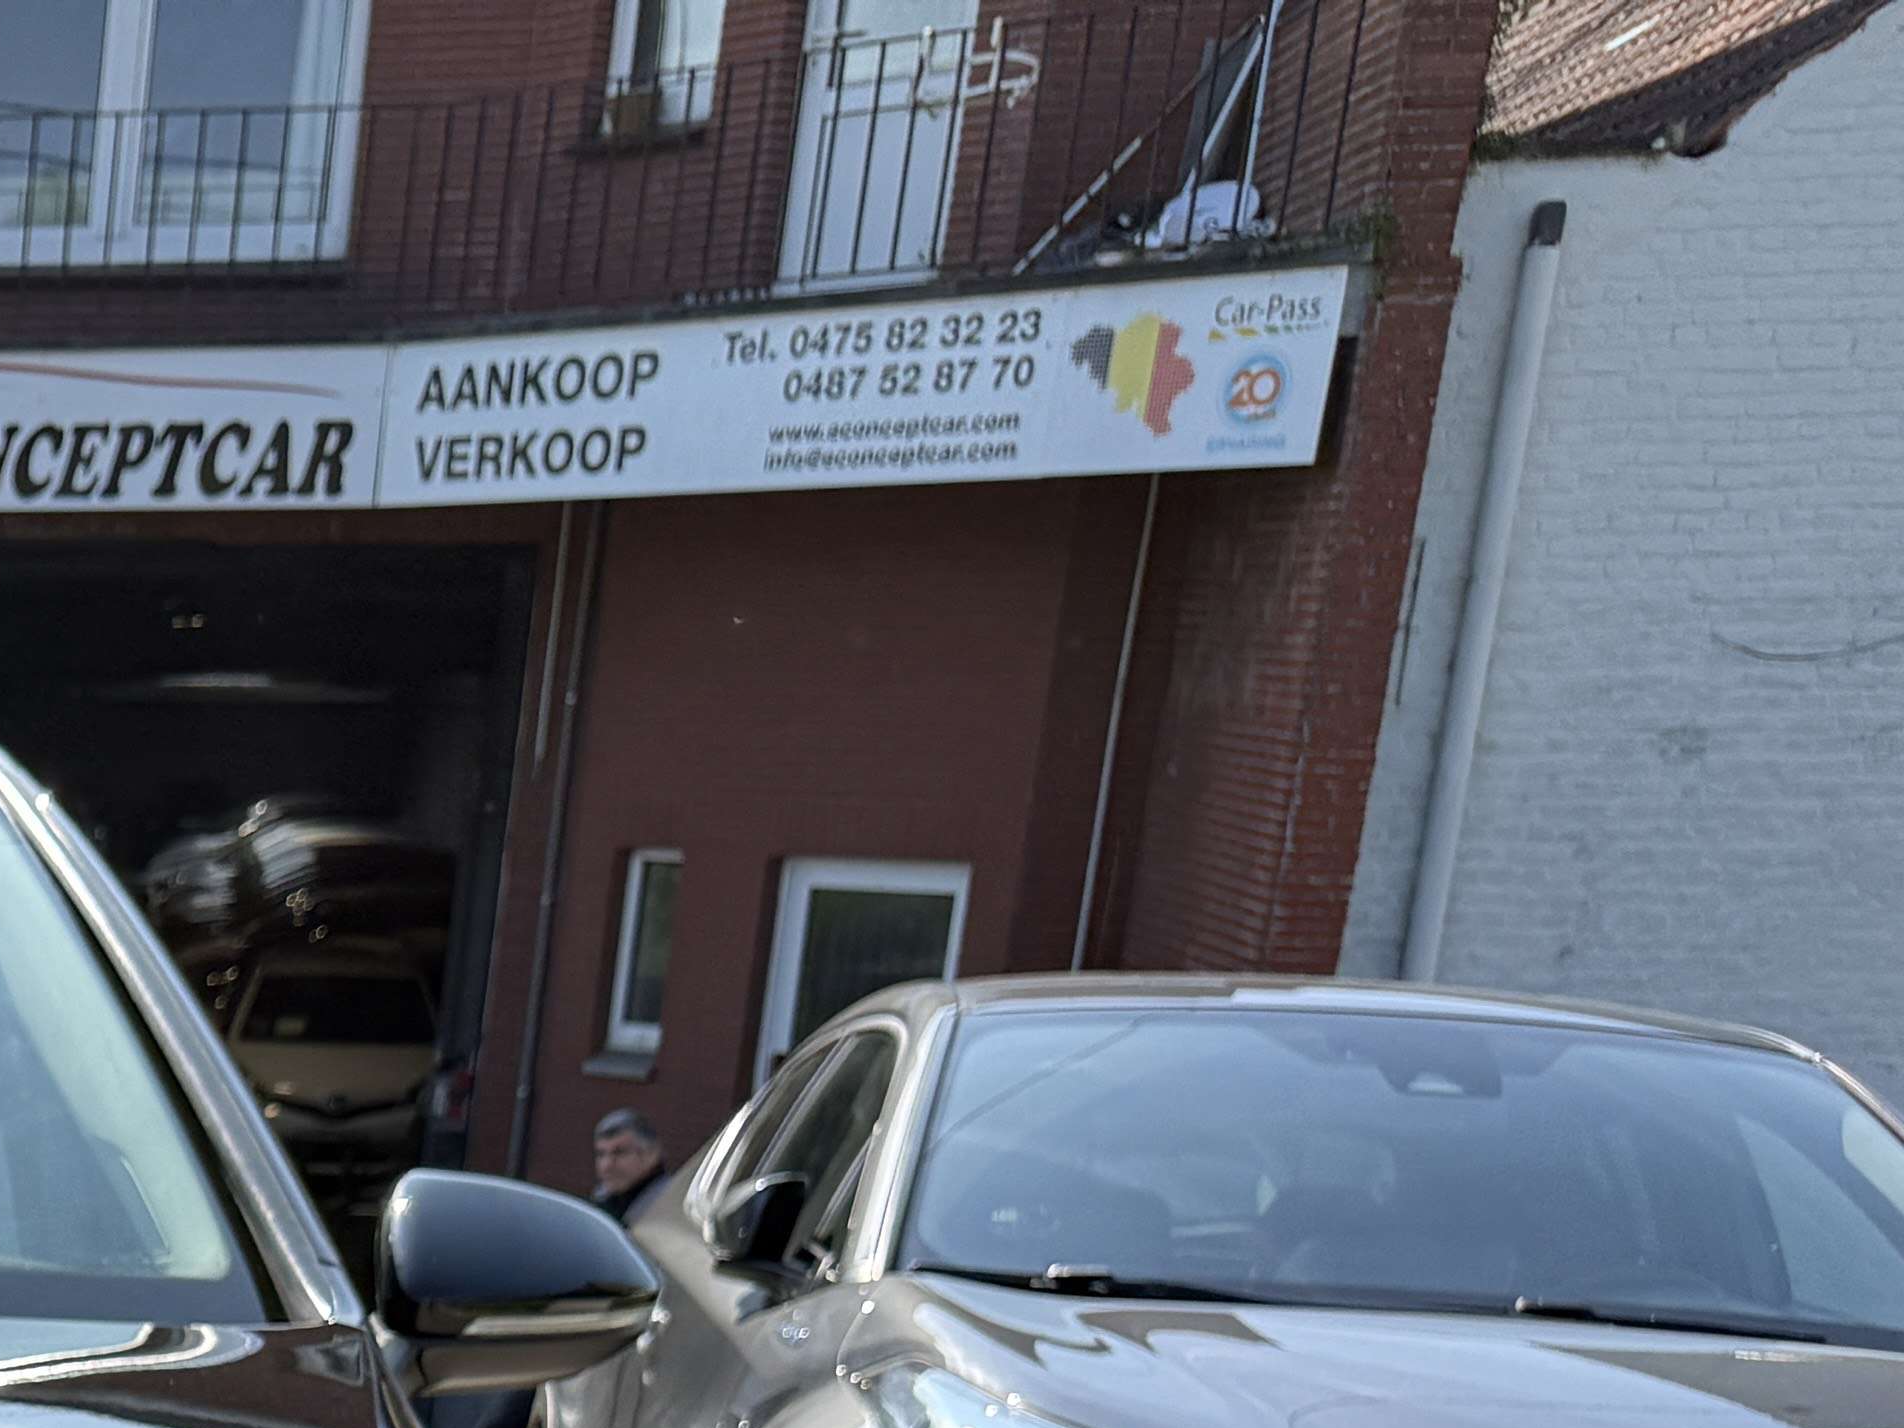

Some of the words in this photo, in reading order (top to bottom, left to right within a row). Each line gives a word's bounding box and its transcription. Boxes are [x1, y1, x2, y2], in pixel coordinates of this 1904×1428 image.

[724, 329, 778, 364] Tel.
[789, 320, 874, 361] 0475
[884, 316, 930, 352] 82
[939, 312, 985, 348] 32
[996, 307, 1042, 344] 23
[1215, 293, 1321, 327] Car-Pass
[417, 349, 660, 414] AANKOOP
[782, 365, 866, 402] 0487
[878, 362, 922, 397] 52
[932, 358, 978, 392] 87
[992, 354, 1036, 389] 70
[1228, 367, 1282, 409] 20
[415, 421, 648, 483] VERKOOP
